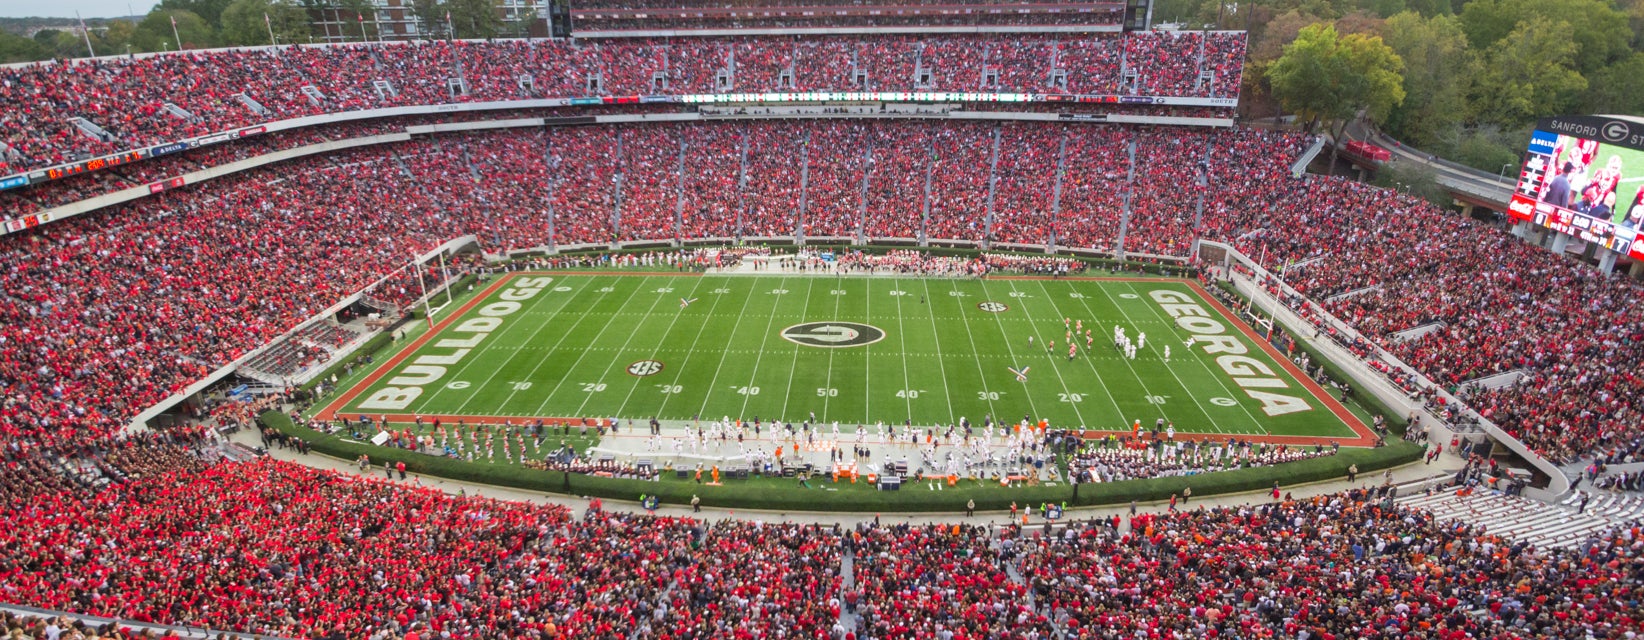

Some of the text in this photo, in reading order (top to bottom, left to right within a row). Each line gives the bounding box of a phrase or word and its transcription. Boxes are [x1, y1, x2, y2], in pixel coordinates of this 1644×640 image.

[1550, 120, 1597, 136] SANFORD
[165, 144, 182, 152] DELTA
[1536, 138, 1555, 148] DELTA
[1535, 213, 1543, 225] 0
[1617, 238, 1626, 251] 7
[357, 276, 554, 410] BULLDOGS
[1148, 289, 1313, 416] GEORGIA
[629, 360, 663, 376] SEC
[511, 381, 533, 391] 10
[582, 382, 608, 392] 20
[660, 384, 684, 394] 30
[737, 386, 761, 396] 40
[816, 387, 839, 397] 50
[895, 389, 919, 399] 40
[978, 391, 1000, 400] 30
[1058, 393, 1083, 403] 20
[1144, 395, 1167, 405] 10
